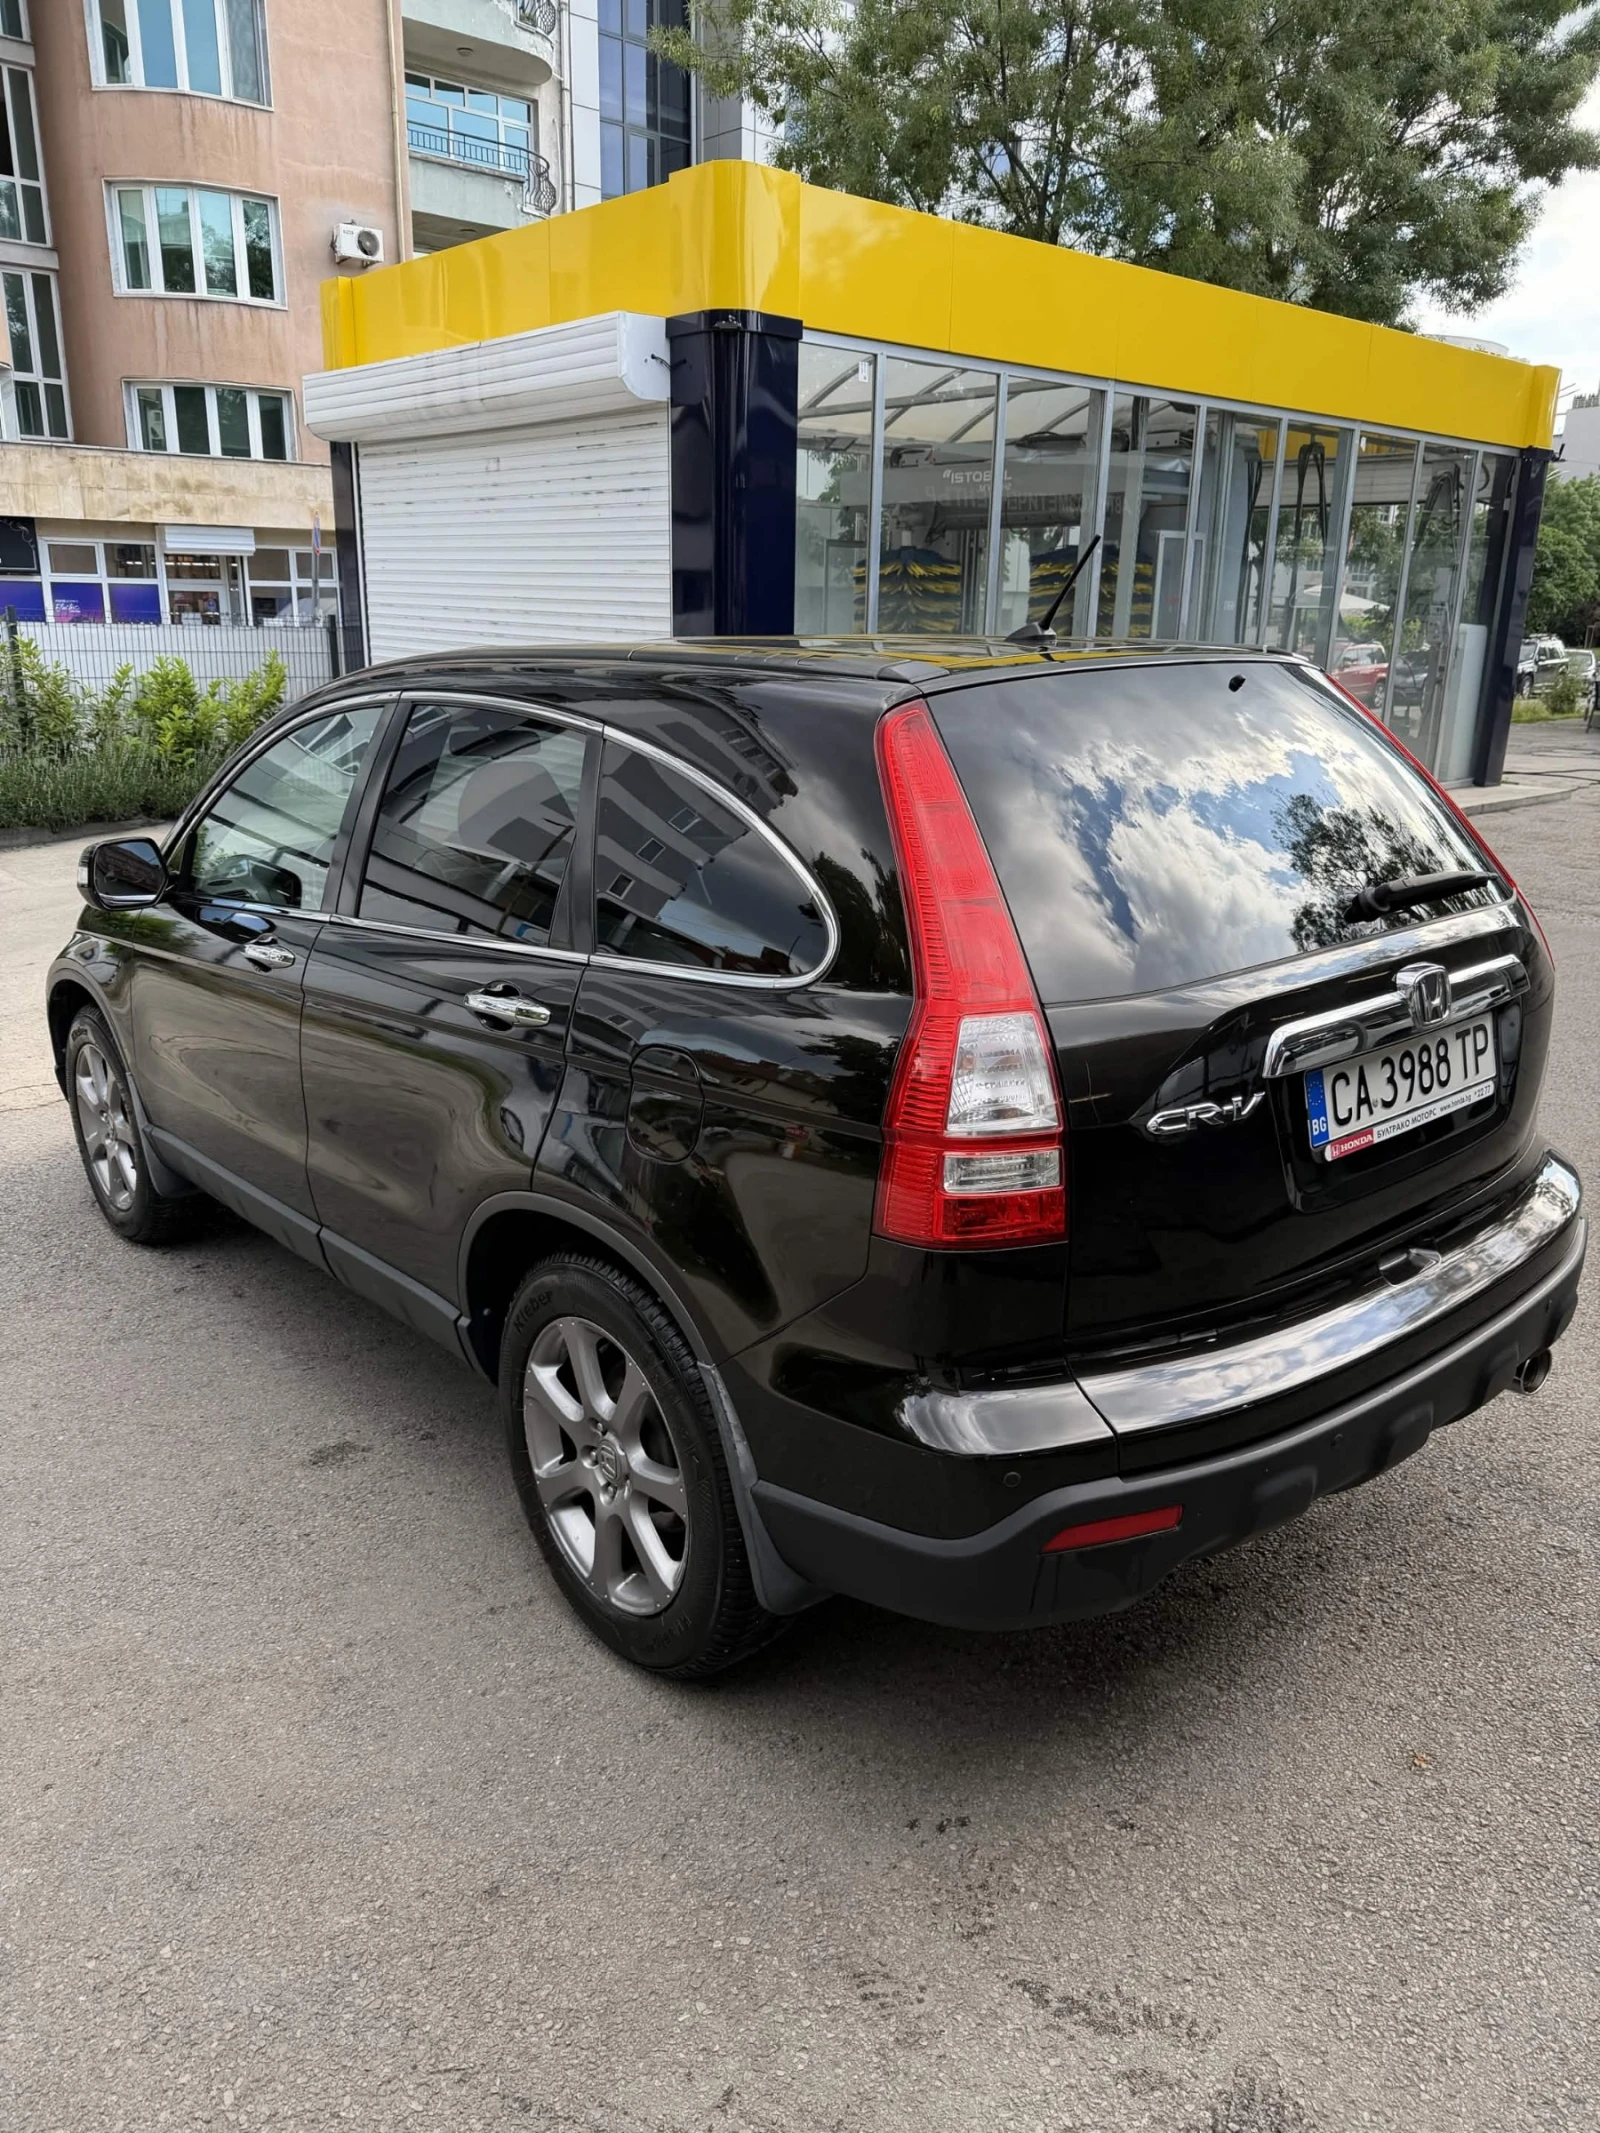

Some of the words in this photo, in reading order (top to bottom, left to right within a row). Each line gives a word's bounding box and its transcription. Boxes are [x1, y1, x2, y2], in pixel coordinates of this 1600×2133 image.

[950, 470, 1012, 485] ISTOBL
[1331, 1064, 1374, 1127] CA
[1380, 1036, 1452, 1109] 3988
[1455, 1023, 1489, 1080] TP
[1312, 1116, 1327, 1136] BG
[1339, 1134, 1373, 1152] HONDA
[1411, 1107, 1437, 1126] МОТОРС
